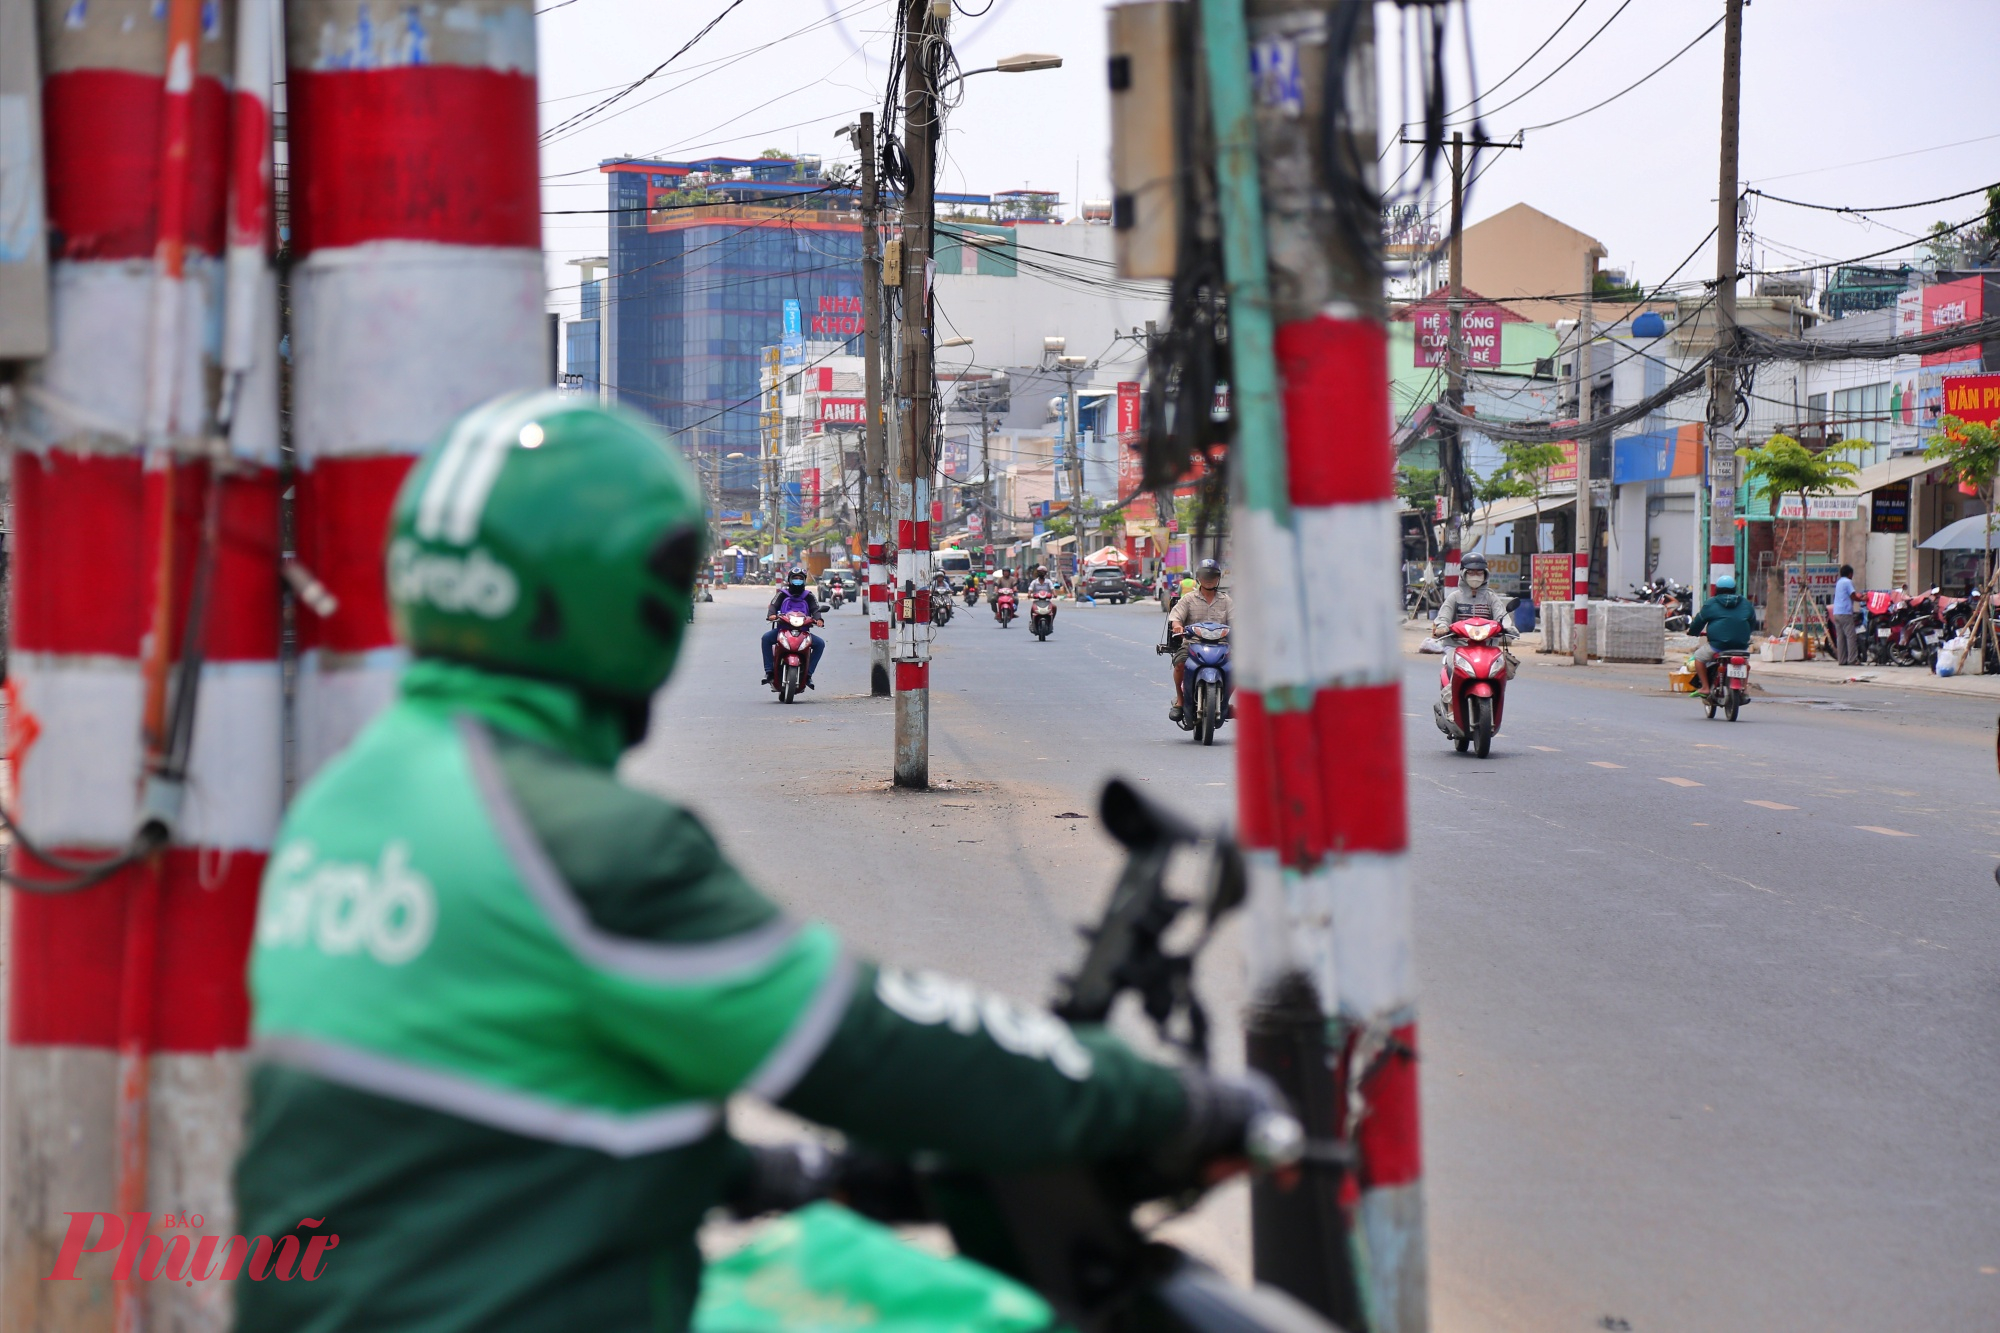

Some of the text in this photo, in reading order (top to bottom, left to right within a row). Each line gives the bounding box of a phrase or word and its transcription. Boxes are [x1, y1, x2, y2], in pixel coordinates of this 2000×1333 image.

[818, 296, 862, 313] NHA
[1932, 300, 1967, 326] viettel
[812, 317, 865, 334] KHOA
[1473, 348, 1490, 363] BÉ
[1948, 384, 1980, 411] VĂN
[824, 403, 855, 420] ANH
